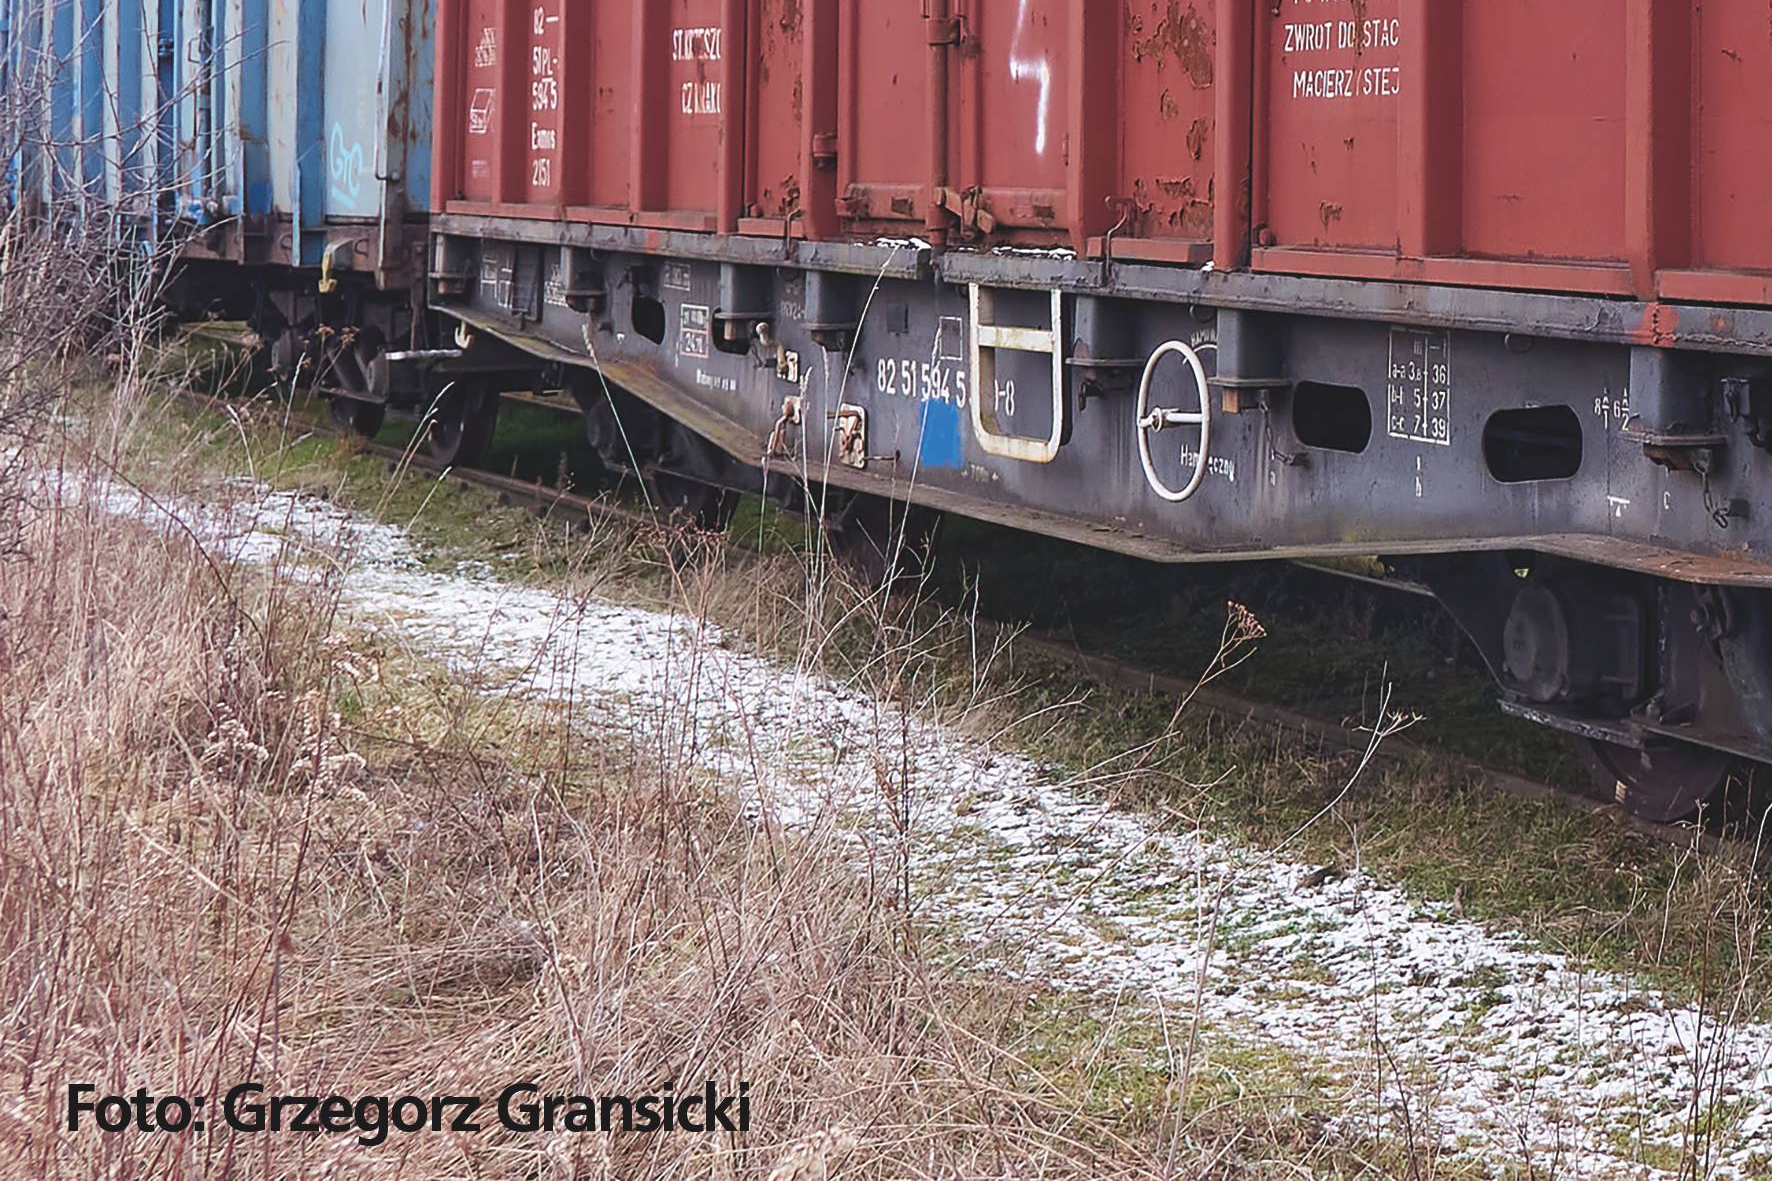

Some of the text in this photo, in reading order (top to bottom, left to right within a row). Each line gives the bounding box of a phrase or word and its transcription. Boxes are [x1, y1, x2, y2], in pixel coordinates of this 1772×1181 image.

[1284, 21, 1333, 52] ZWROT
[1338, 20, 1356, 49] DO
[878, 358, 896, 395] 82
[901, 360, 917, 398] 51
[956, 370, 967, 409] 5
[1431, 363, 1447, 385] 36
[1412, 388, 1421, 409] 5
[1431, 391, 1447, 411] 37
[1413, 414, 1421, 435] 7
[1430, 416, 1447, 439] 39
